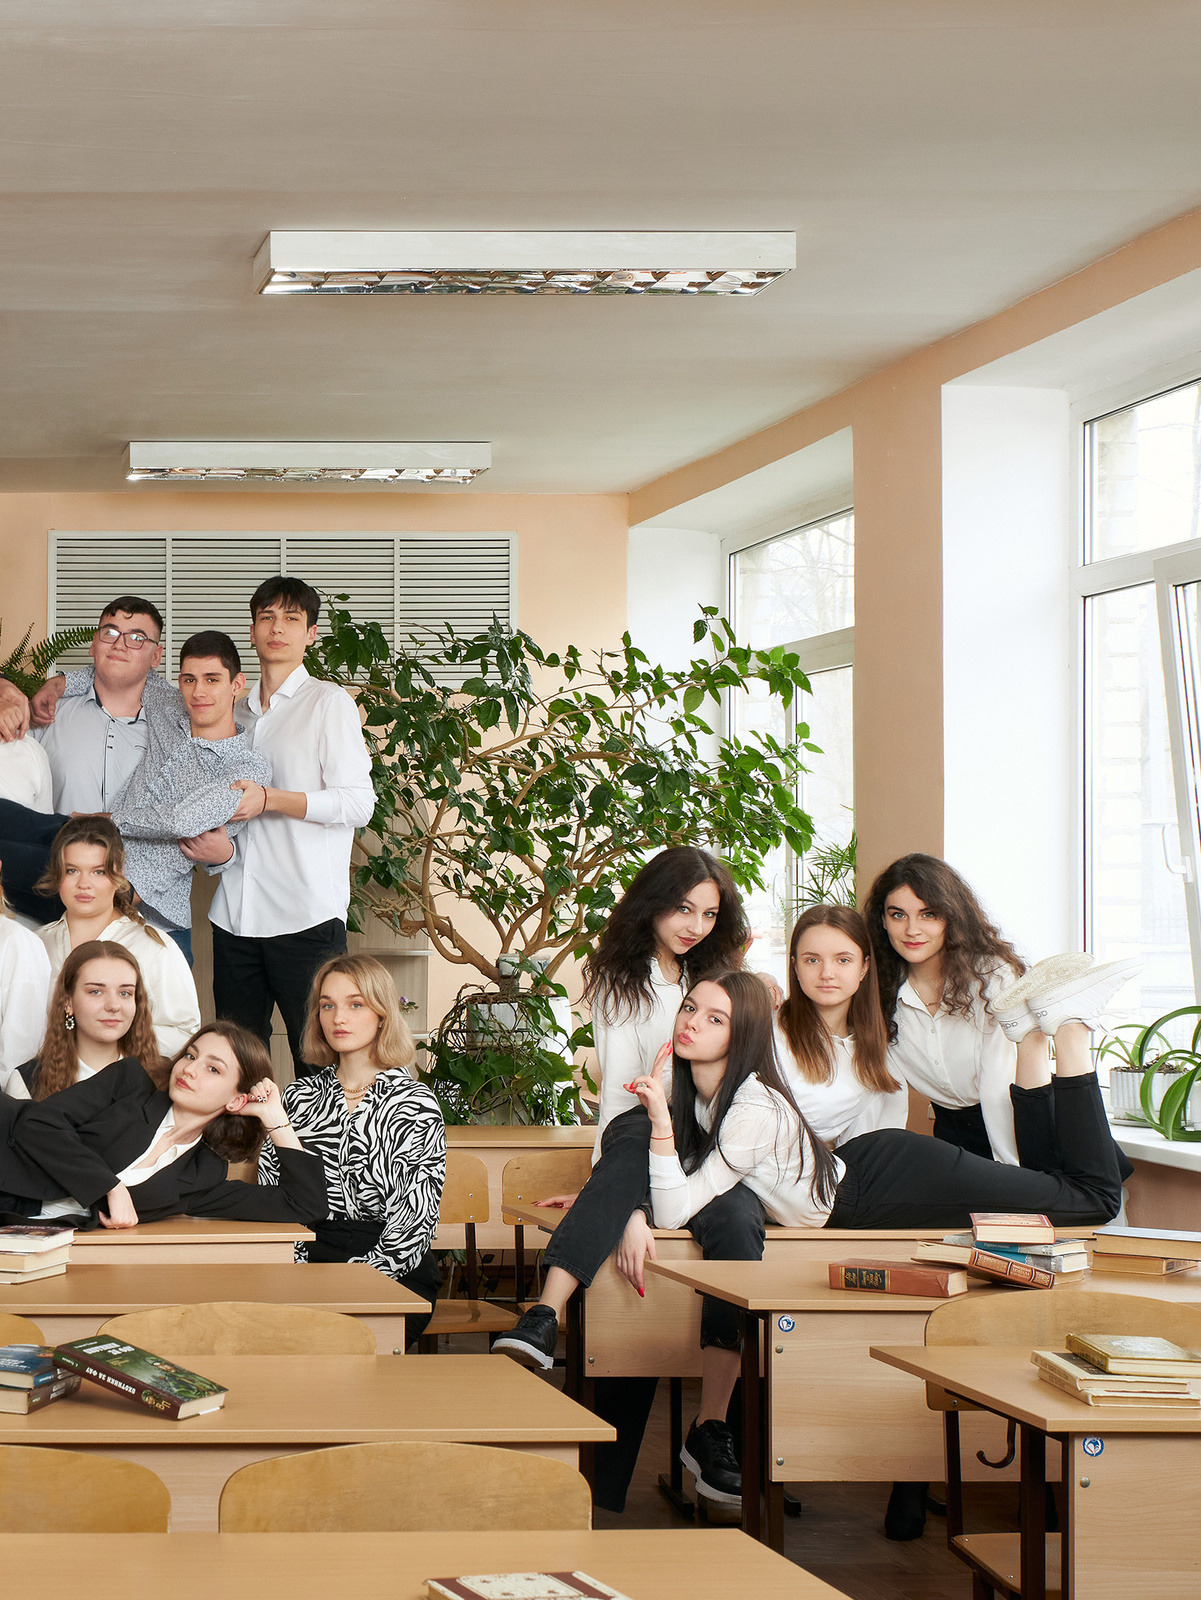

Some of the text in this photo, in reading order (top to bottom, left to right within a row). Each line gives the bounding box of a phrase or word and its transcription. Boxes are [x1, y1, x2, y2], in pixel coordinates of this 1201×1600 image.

[86, 1367, 98, 1376] ФАУ
[98, 1372, 107, 1381] ЗА
[107, 1376, 136, 1394] ОХОТНИКИ
